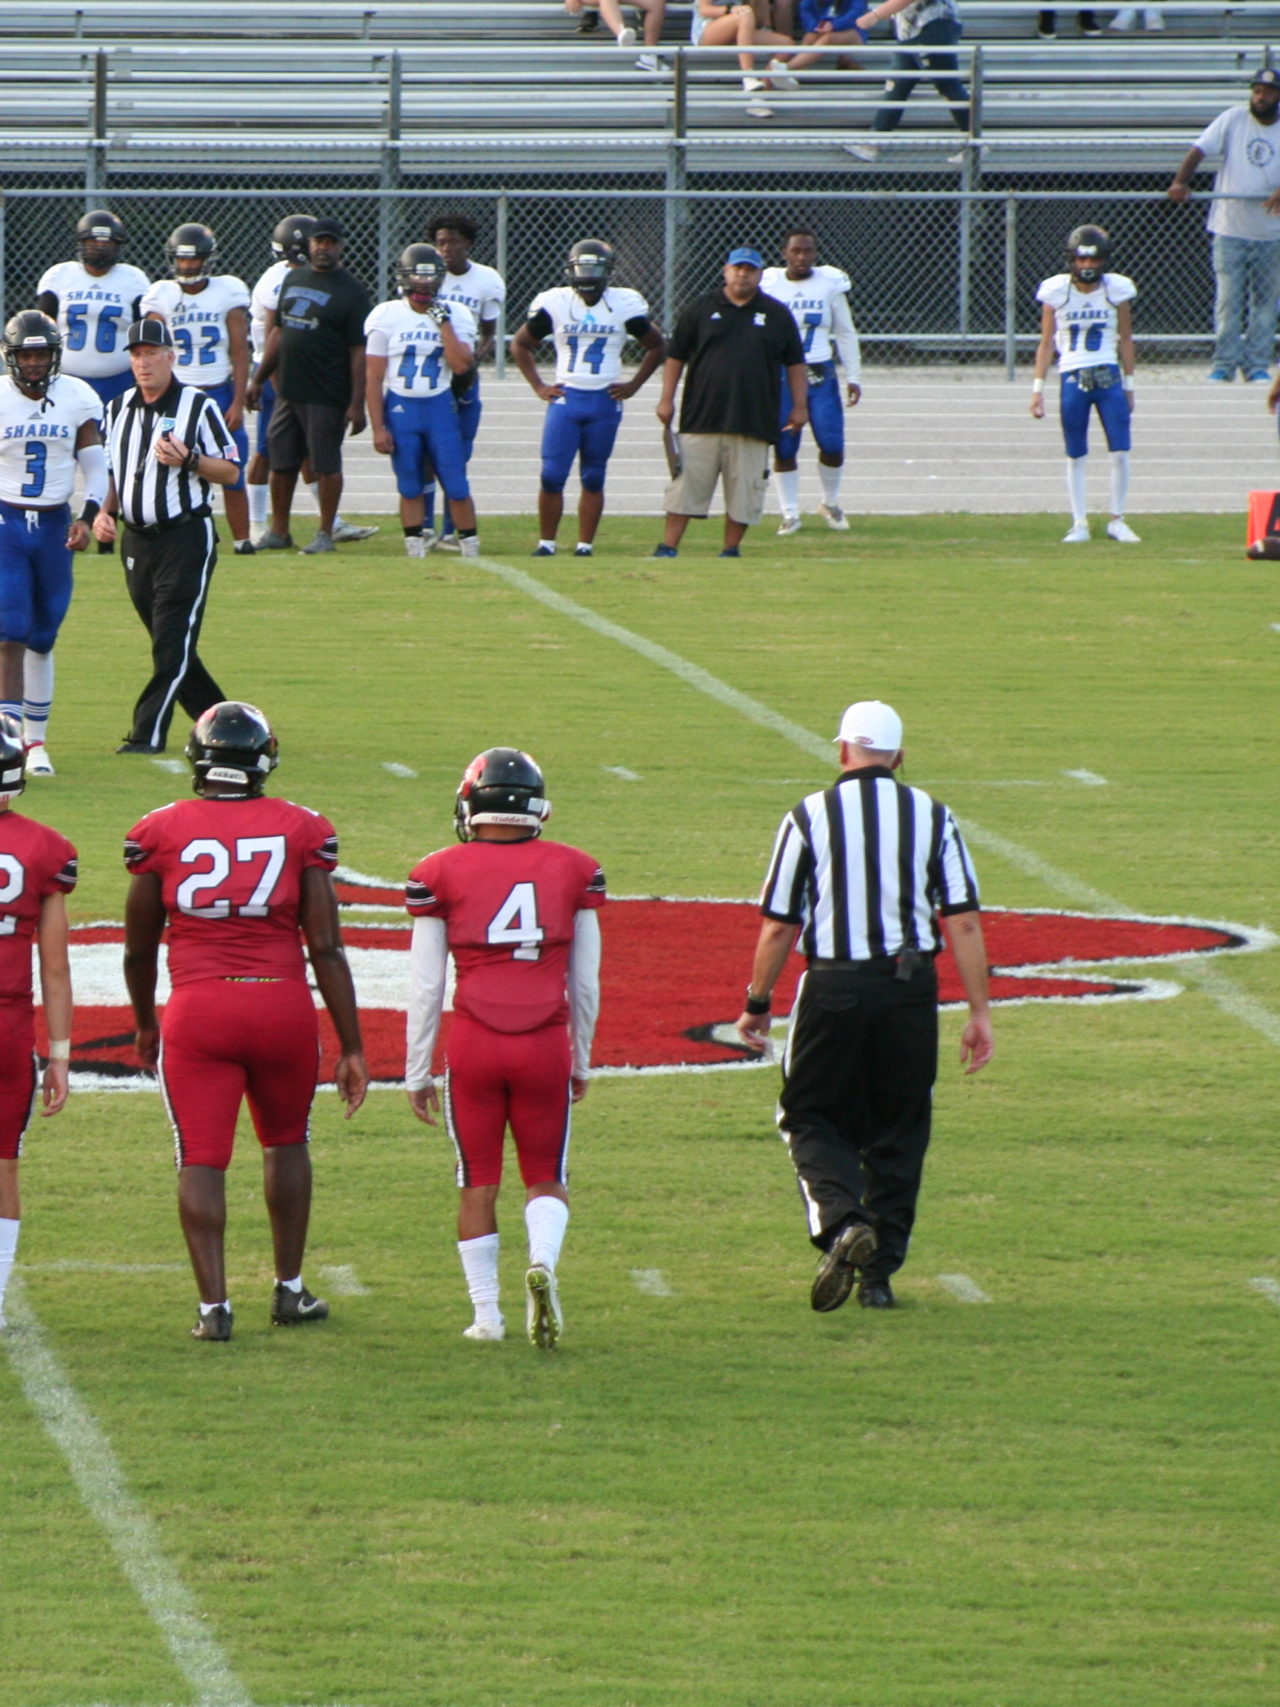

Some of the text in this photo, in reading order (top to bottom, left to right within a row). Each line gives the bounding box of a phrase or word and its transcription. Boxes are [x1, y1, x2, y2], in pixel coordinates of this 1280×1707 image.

[67, 291, 121, 303] SHARKS
[1066, 310, 1109, 320] SHARKS
[172, 312, 220, 327] SHARKS
[563, 323, 615, 335] SHARKS
[173, 326, 221, 366] 32
[566, 335, 609, 375] 14
[398, 344, 444, 390] 44
[3, 424, 69, 439] SHARKS
[21, 440, 48, 498] 3
[176, 833, 287, 919] 27
[486, 882, 546, 962] 4
